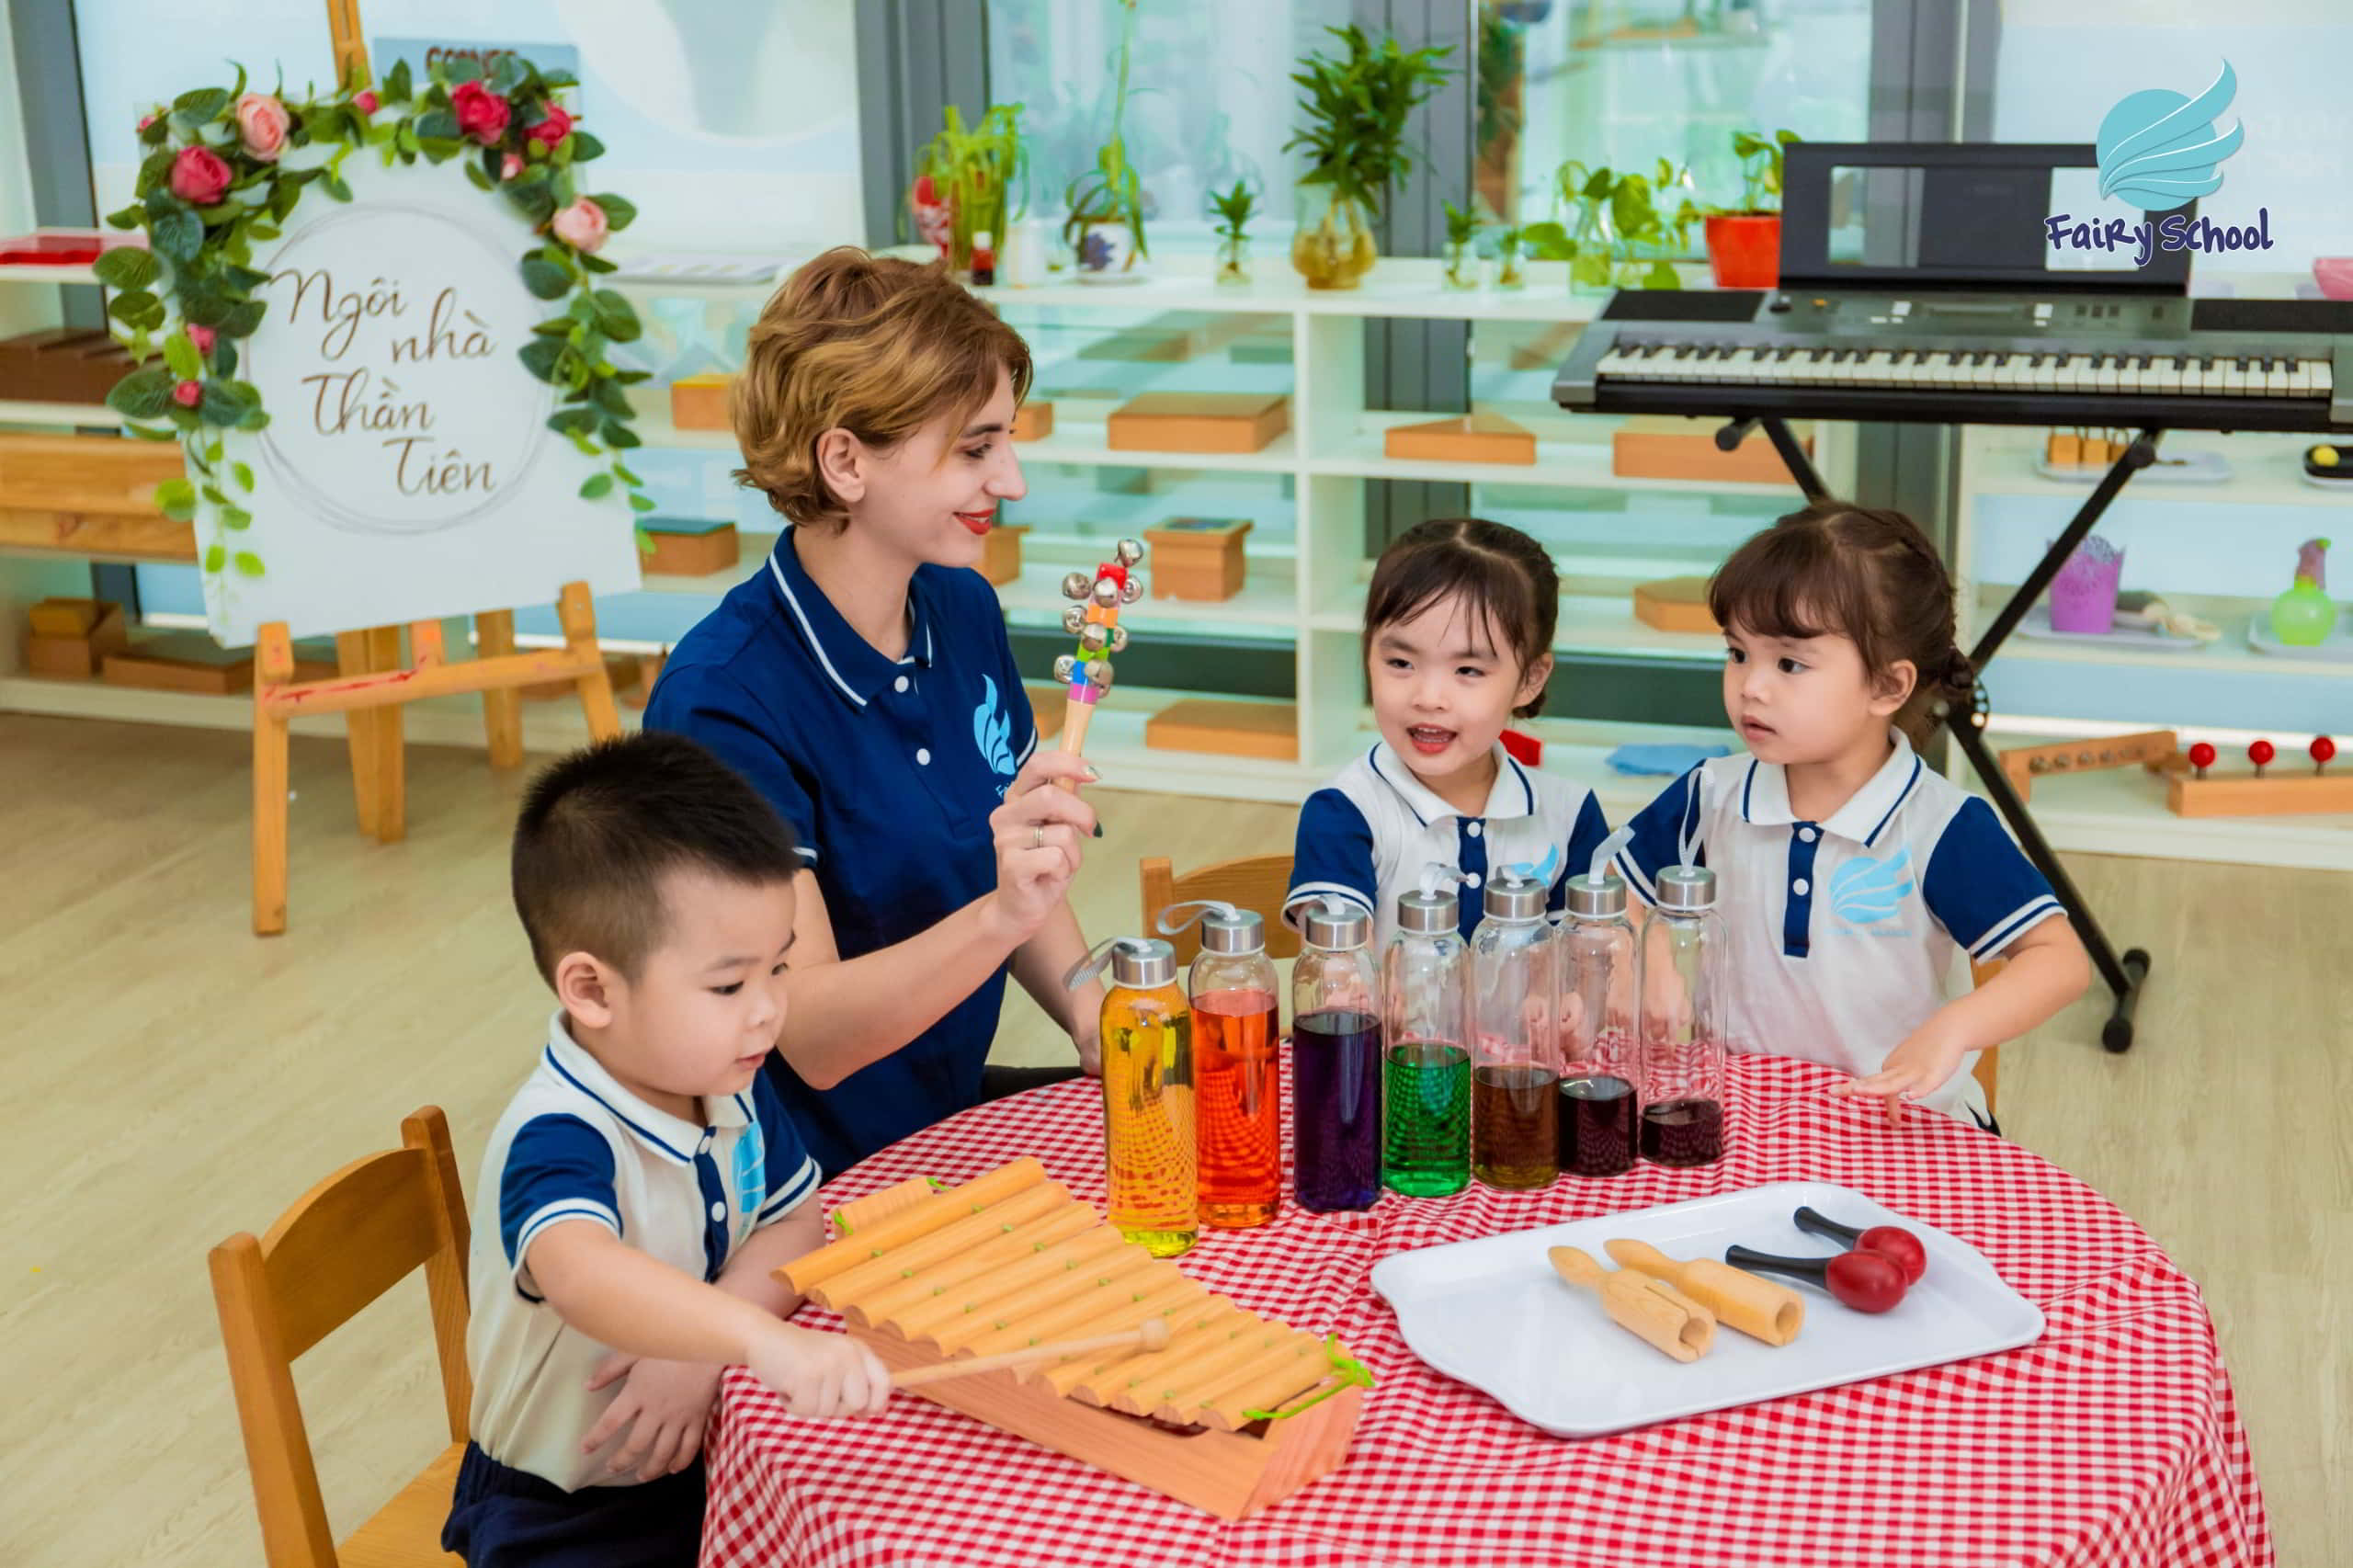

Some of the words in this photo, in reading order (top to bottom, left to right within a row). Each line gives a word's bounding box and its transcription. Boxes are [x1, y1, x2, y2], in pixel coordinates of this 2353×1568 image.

[268, 268, 407, 361] Ngôi
[391, 286, 497, 363] nhà
[301, 366, 436, 435] Thần
[381, 436, 495, 496] Tiên
